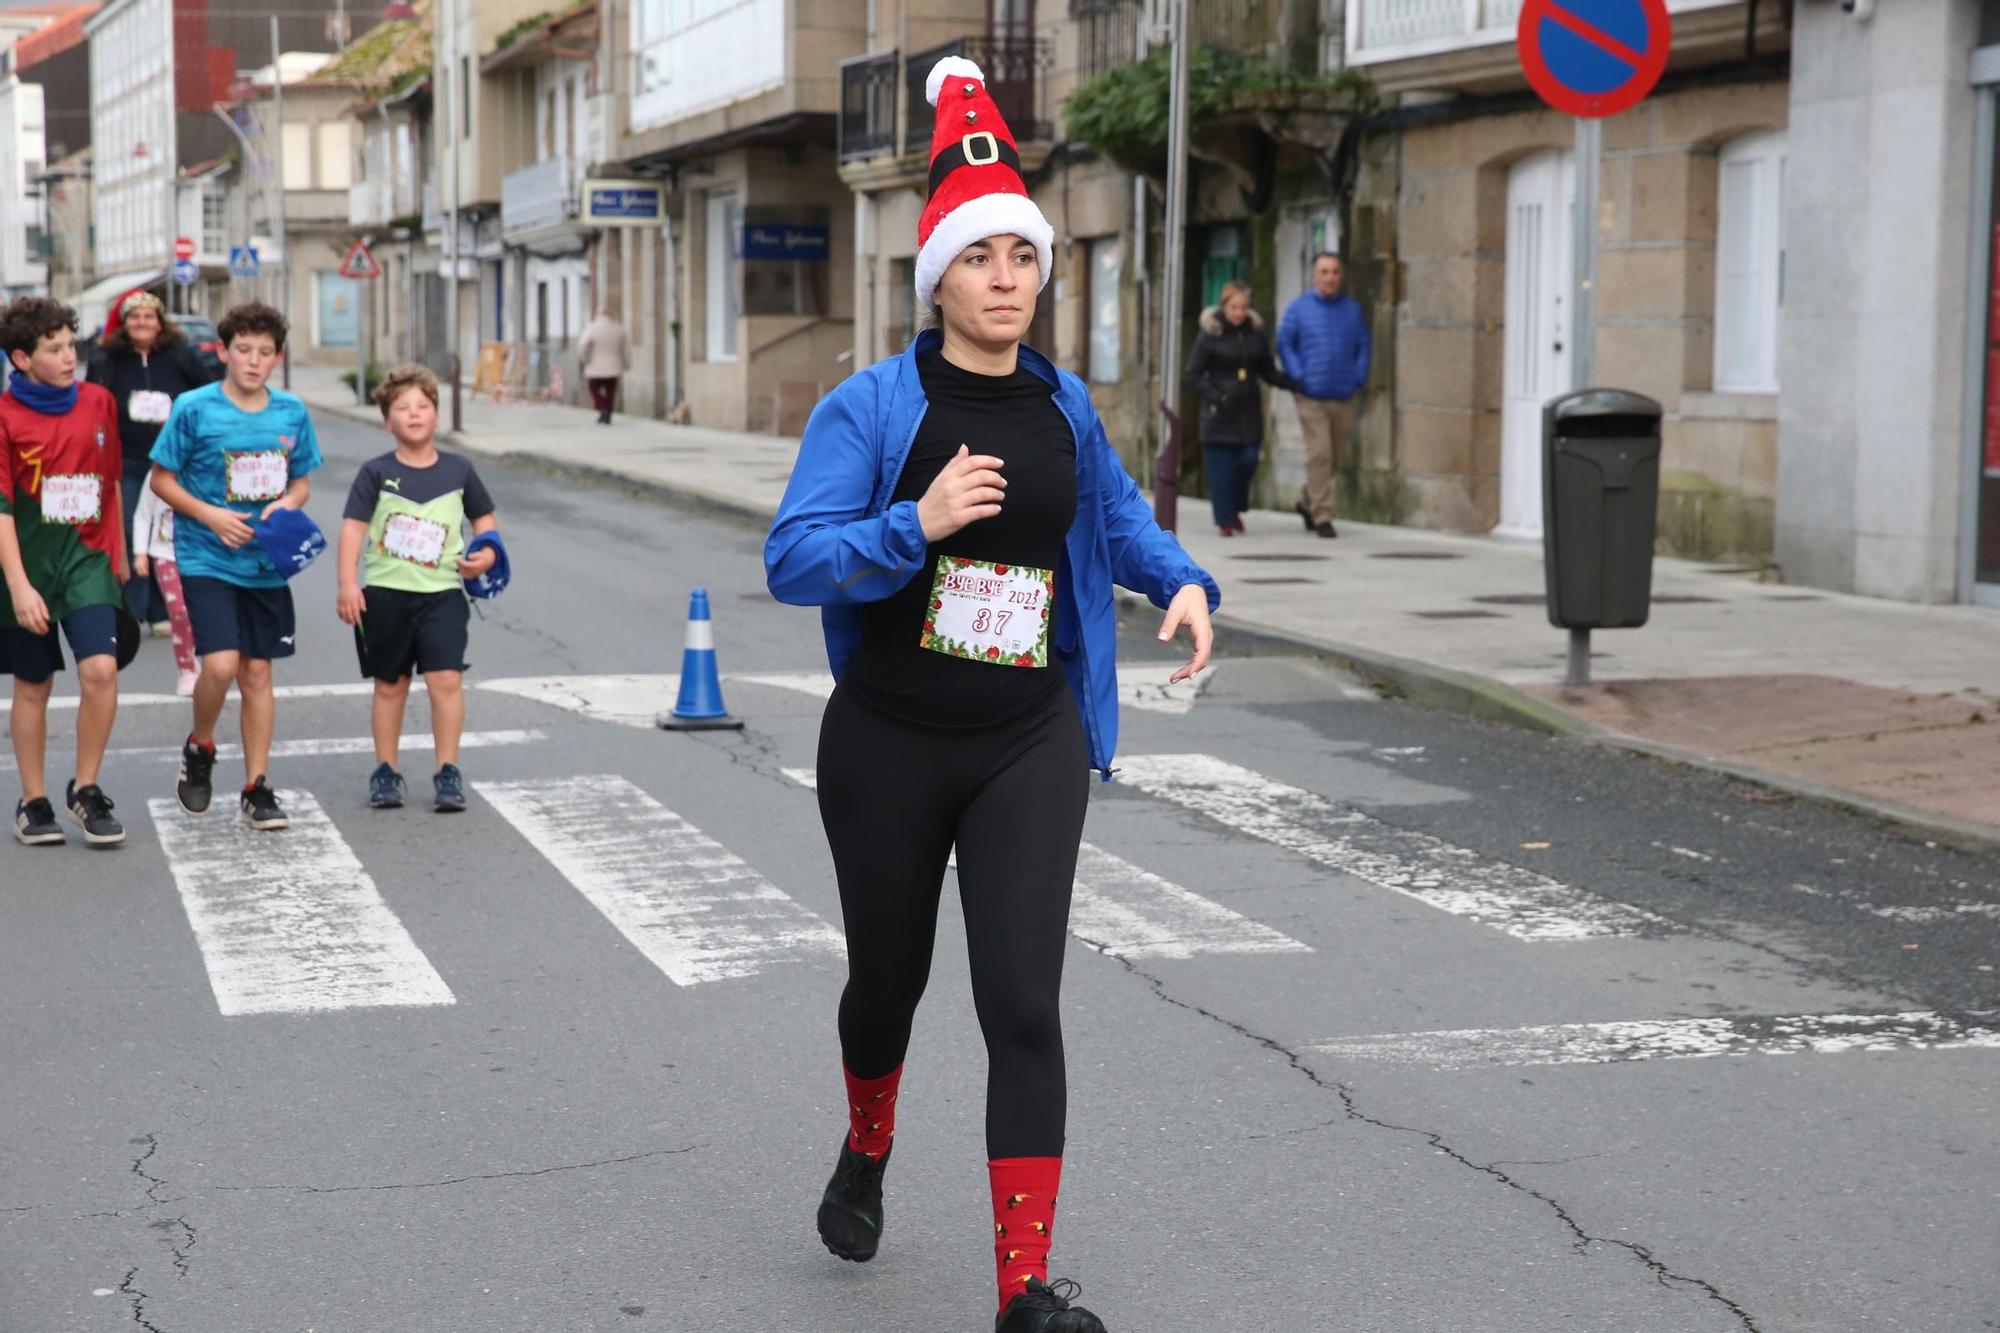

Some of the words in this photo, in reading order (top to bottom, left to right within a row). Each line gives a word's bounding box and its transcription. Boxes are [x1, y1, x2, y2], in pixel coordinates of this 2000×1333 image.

[27, 458, 42, 494] 7
[1008, 590, 1039, 605] 2023
[972, 608, 1013, 636] 37
